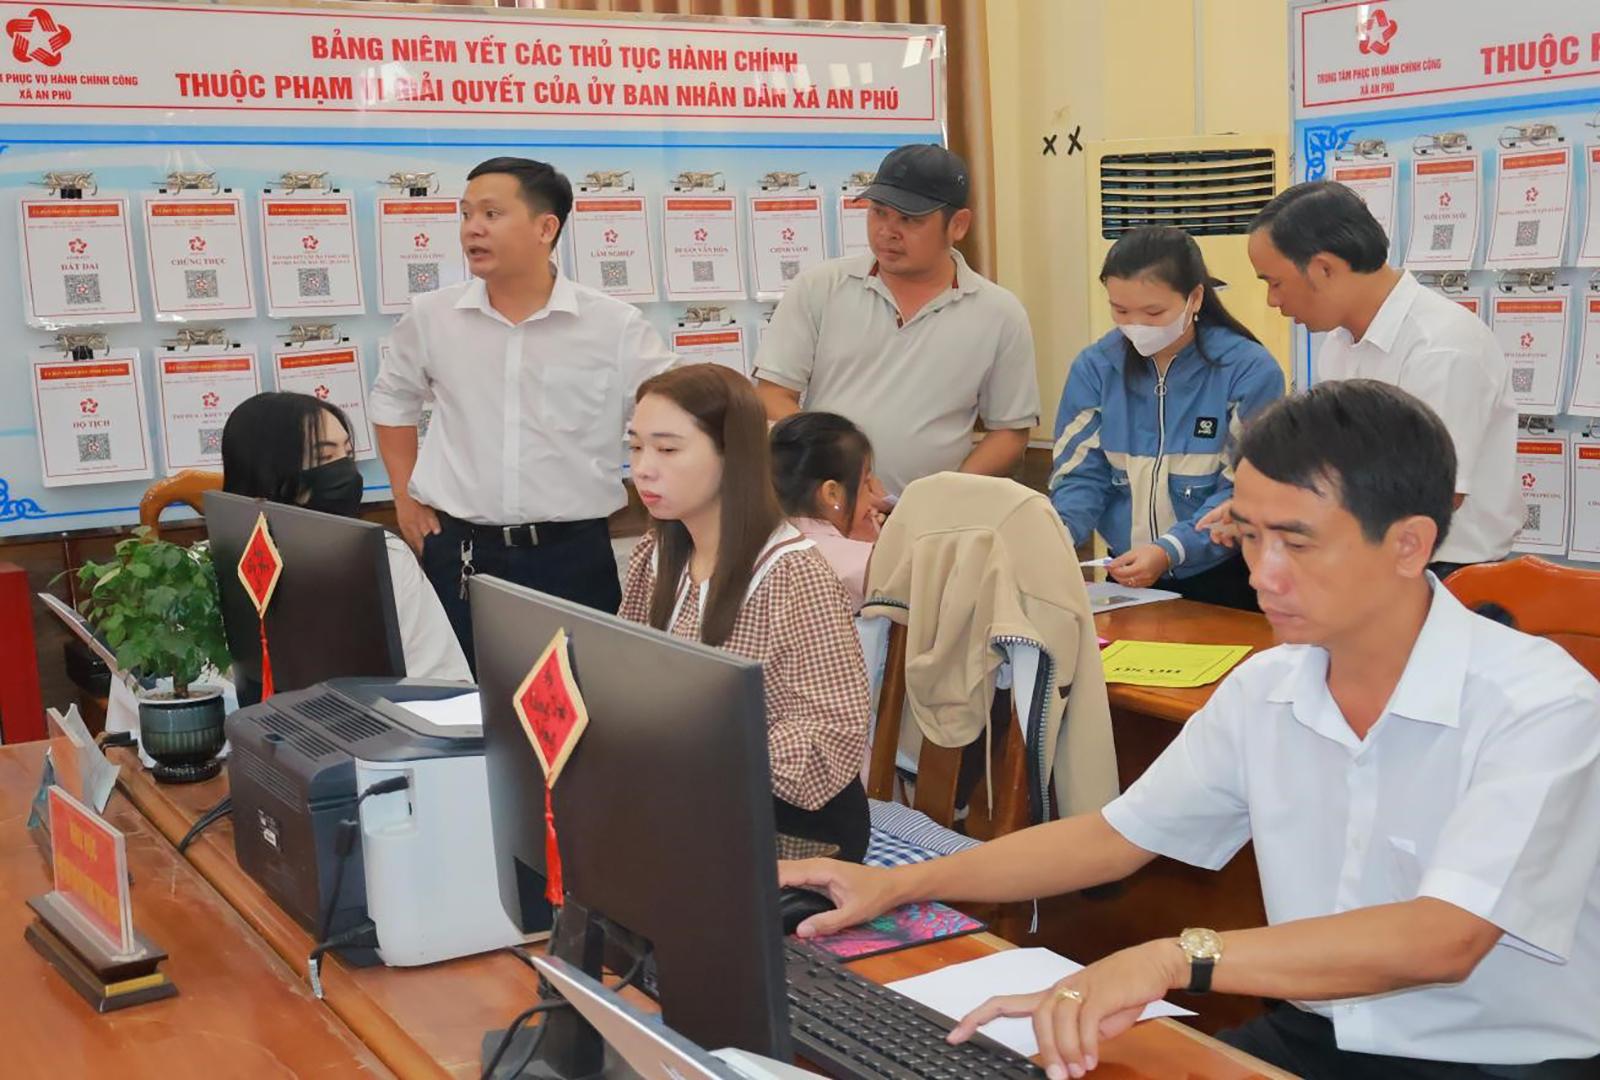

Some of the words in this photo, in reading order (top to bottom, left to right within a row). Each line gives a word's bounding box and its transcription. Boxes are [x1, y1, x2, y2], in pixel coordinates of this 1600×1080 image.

[311, 28, 385, 61] BẢNG
[391, 34, 458, 63] NIÊM
[464, 34, 507, 64] YẾT
[514, 38, 562, 66] CÁC
[568, 38, 612, 67] THỦ
[618, 46, 661, 73] TỤC
[667, 44, 728, 72] HÀNH
[734, 47, 798, 73] CHÍNH
[1480, 33, 1579, 74] THUỘC
[5, 73, 32, 85] PHỤC
[35, 74, 48, 86] VỤ
[51, 73, 77, 85] HÀNH
[80, 74, 110, 85] CHÍNH
[112, 75, 138, 86] CÔNG
[175, 69, 266, 103] THUỘC
[276, 73, 353, 105] PHẠM
[452, 73, 526, 105] QUYẾT
[534, 75, 581, 104] CỦA
[587, 76, 616, 105] ỦY
[624, 84, 669, 106] BAN
[677, 81, 737, 108] NHÂN
[793, 84, 820, 109] XÃ
[826, 89, 854, 109] AN
[860, 86, 899, 110] PHÚ
[1316, 72, 1337, 85] TRUNG
[1353, 67, 1371, 81] PHỤC
[35, 90, 49, 99] AN
